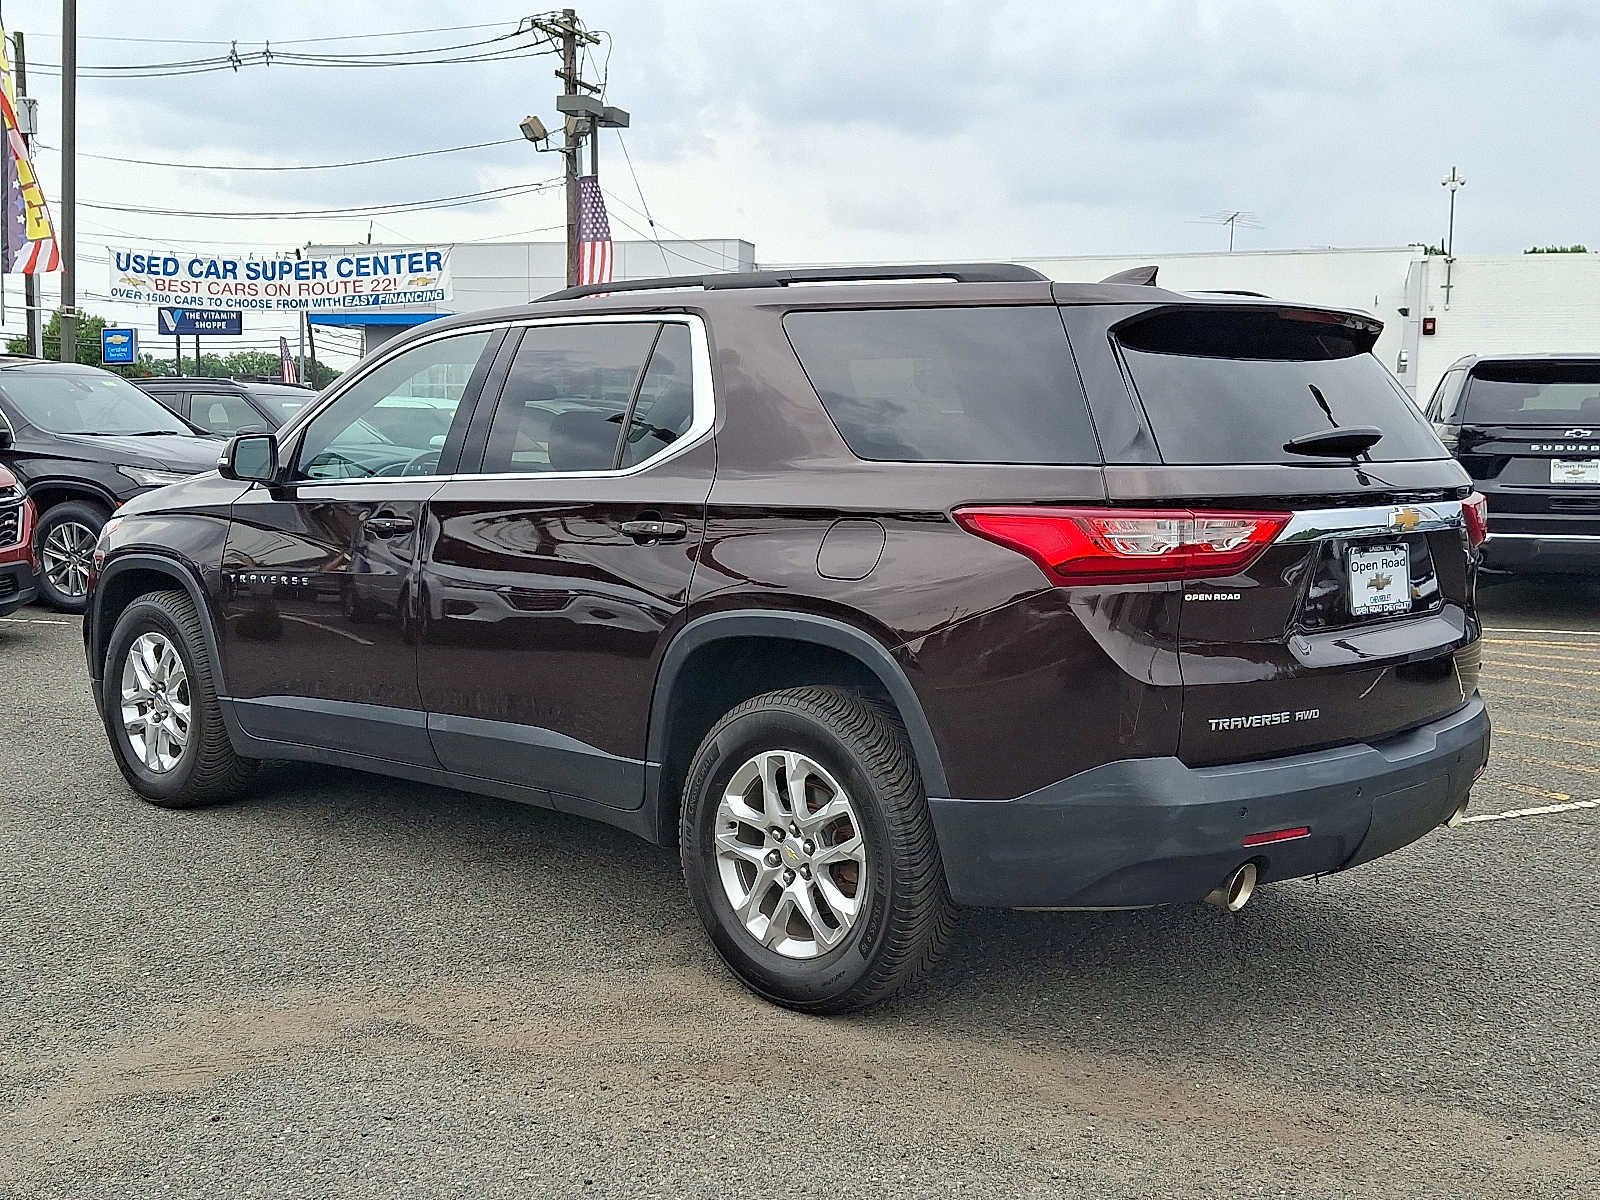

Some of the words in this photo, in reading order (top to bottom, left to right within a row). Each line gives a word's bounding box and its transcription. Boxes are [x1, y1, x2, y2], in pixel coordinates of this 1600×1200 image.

[116, 252, 180, 277] USED
[187, 258, 238, 280] CAR
[245, 260, 328, 281] SUPER
[336, 251, 443, 278] CENTER
[154, 278, 202, 294] BEST
[207, 281, 259, 297] CARS
[264, 283, 291, 297] ON
[298, 280, 364, 297] ROUTE
[370, 277, 398, 293] 22!
[110, 287, 142, 300] OVER
[146, 292, 171, 304] 1500
[174, 295, 204, 306] CARS
[207, 297, 223, 307] TO
[225, 298, 273, 309] CHOOSE
[276, 299, 309, 309] FROM
[311, 296, 342, 308] WITH
[344, 294, 378, 307] EASY
[378, 289, 443, 305] FINANCING
[184, 311, 201, 320] THE
[202, 311, 237, 320] VITAMIN
[195, 321, 227, 329] SHOPPE
[1351, 561, 1378, 574] Open
[1381, 557, 1405, 569] Road
[229, 574, 309, 586] TRAVERSE
[1184, 593, 1213, 601] OPEN
[1213, 593, 1241, 601] ROAD
[1208, 711, 1290, 731] TRAVERSE
[1294, 709, 1320, 722] AWD
